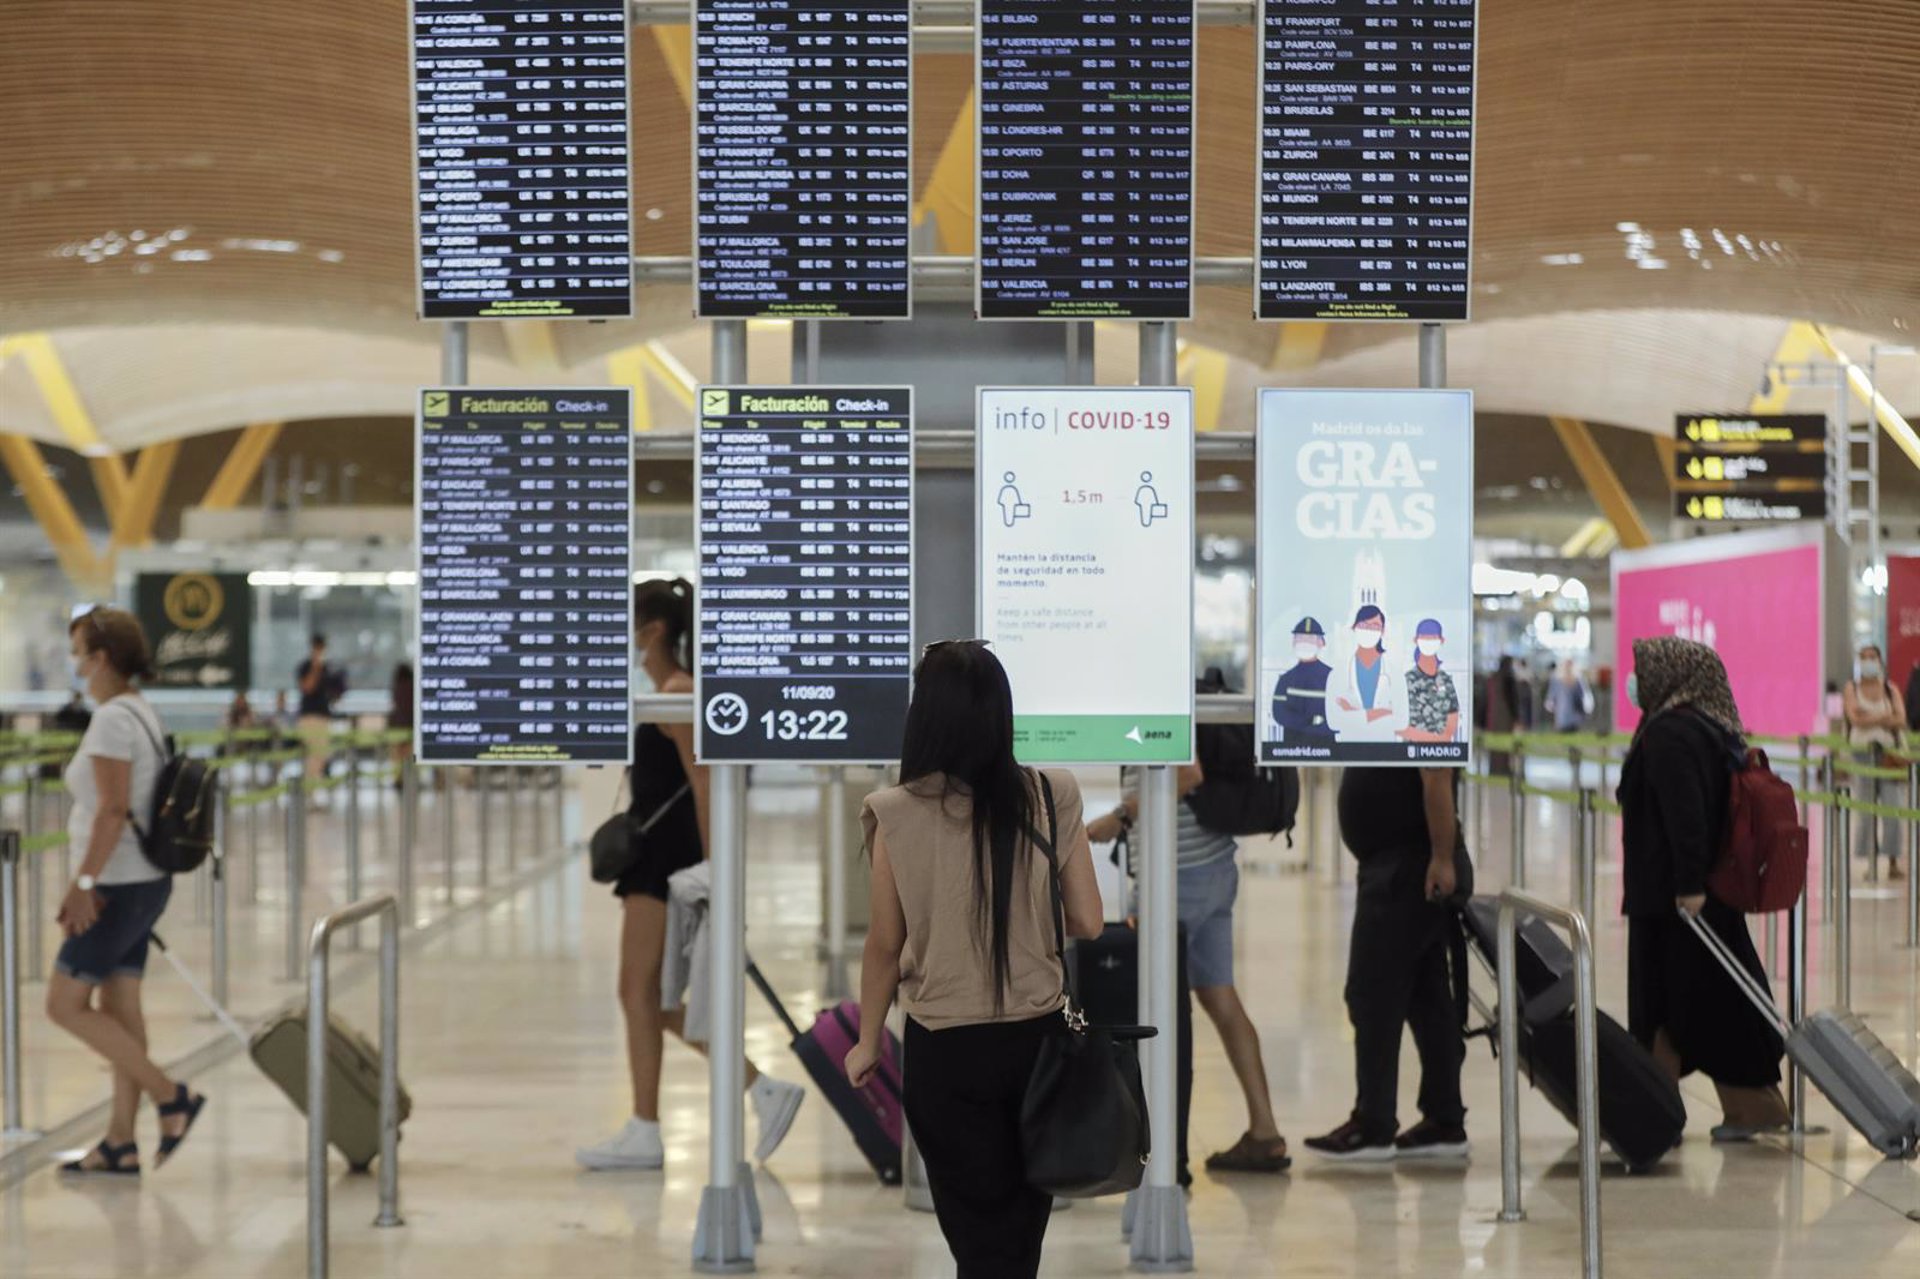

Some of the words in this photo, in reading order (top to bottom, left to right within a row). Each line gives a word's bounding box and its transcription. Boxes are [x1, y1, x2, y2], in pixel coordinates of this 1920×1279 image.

[1002, 15, 1038, 23] BILBAO
[1130, 15, 1142, 23] T4
[1412, 18, 1424, 27] T4
[1002, 38, 1079, 47] FUERTEVENTURA
[1130, 38, 1141, 46] T4
[1285, 41, 1336, 49] PAMPLONA
[1412, 41, 1423, 50] T4
[1129, 60, 1141, 68] T4
[1285, 62, 1335, 71] PARIS-ORY
[1411, 63, 1422, 72] T4
[1448, 64, 1456, 72] to
[1002, 82, 1048, 90] ASTURIAS
[1129, 82, 1141, 90] T4
[1284, 84, 1304, 93] SAN
[1305, 84, 1358, 93] SEBASTIAN
[1410, 85, 1422, 94] T4
[1129, 104, 1141, 112] T4
[1284, 106, 1334, 115] BRUSELAS
[1410, 107, 1421, 116] T4
[1129, 126, 1141, 134] T4
[1410, 129, 1421, 138] T4
[1002, 148, 1044, 157] OPORTO
[1129, 148, 1140, 156] T4
[1283, 150, 1318, 159] ZURICH
[1409, 151, 1420, 160] T4
[1129, 170, 1140, 178] T4
[1283, 172, 1310, 181] GRAN
[1311, 172, 1352, 181] CANARIA
[1408, 173, 1420, 182] T4
[1128, 192, 1140, 200] T4
[1282, 194, 1319, 203] MUNICH
[1408, 195, 1419, 204] T4
[1002, 214, 1033, 223] JEREZ
[1128, 214, 1140, 223] T4
[1326, 216, 1358, 225] NORTE
[1407, 217, 1419, 226] T4
[1002, 236, 1022, 245] SAN
[1128, 236, 1140, 244] T4
[1407, 239, 1418, 248] T4
[1002, 258, 1036, 267] BERLIN
[1128, 258, 1140, 266] T4
[1282, 260, 1308, 269] LYON
[1406, 260, 1418, 270] T4
[1002, 280, 1048, 289] VALENCIA
[1128, 280, 1139, 288] T4
[1281, 282, 1336, 291] LANZAROTE
[1405, 282, 1417, 292] T4
[461, 396, 548, 413] Facturación
[556, 400, 608, 412] Check-in
[741, 396, 829, 412] Facturación
[836, 399, 889, 412] Check-in
[995, 407, 1046, 430] info
[1068, 412, 1170, 430] COVID-19
[1312, 422, 1362, 435] Madrid
[1366, 426, 1380, 435] os
[1384, 422, 1401, 435] da
[1404, 423, 1424, 435] las
[1296, 440, 1438, 488] GRA-
[1090, 494, 1103, 503] m
[1296, 492, 1436, 540] CIAS
[1038, 553, 1047, 562] la
[1050, 553, 1096, 562] distancia
[997, 566, 1009, 574] de
[1014, 566, 1063, 576] seguridad
[1082, 566, 1104, 574] todo
[781, 686, 835, 700] 11/09/20
[760, 710, 848, 740] 13:22
[1144, 730, 1172, 739] aena
[1272, 746, 1330, 757] esmadrid.com
[1420, 746, 1461, 757] MADRID
